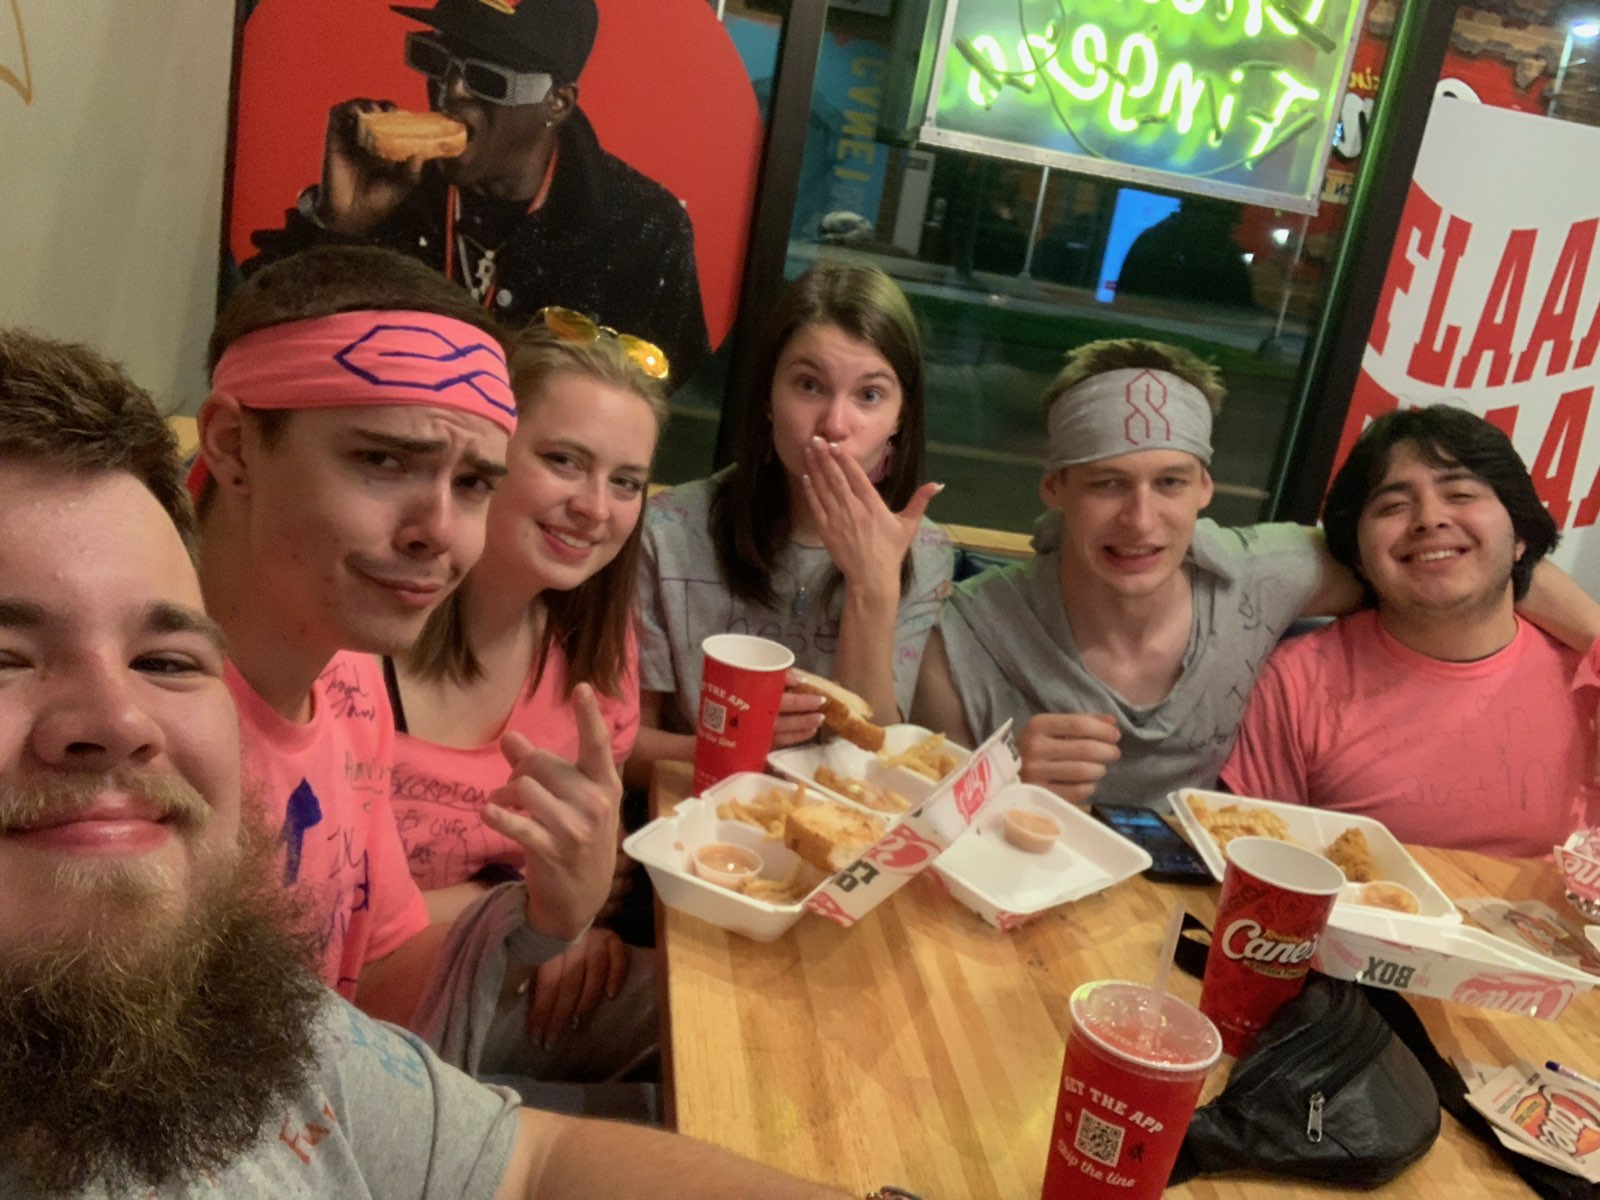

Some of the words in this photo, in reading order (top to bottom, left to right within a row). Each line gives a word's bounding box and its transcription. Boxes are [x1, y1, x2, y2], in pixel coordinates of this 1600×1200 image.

[727, 694, 750, 711] APP
[1362, 956, 1416, 989] BOX
[1090, 1087, 1128, 1116] THE
[1128, 1111, 1164, 1134] APP
[1081, 1161, 1104, 1180] the
[1106, 1171, 1136, 1188] line
